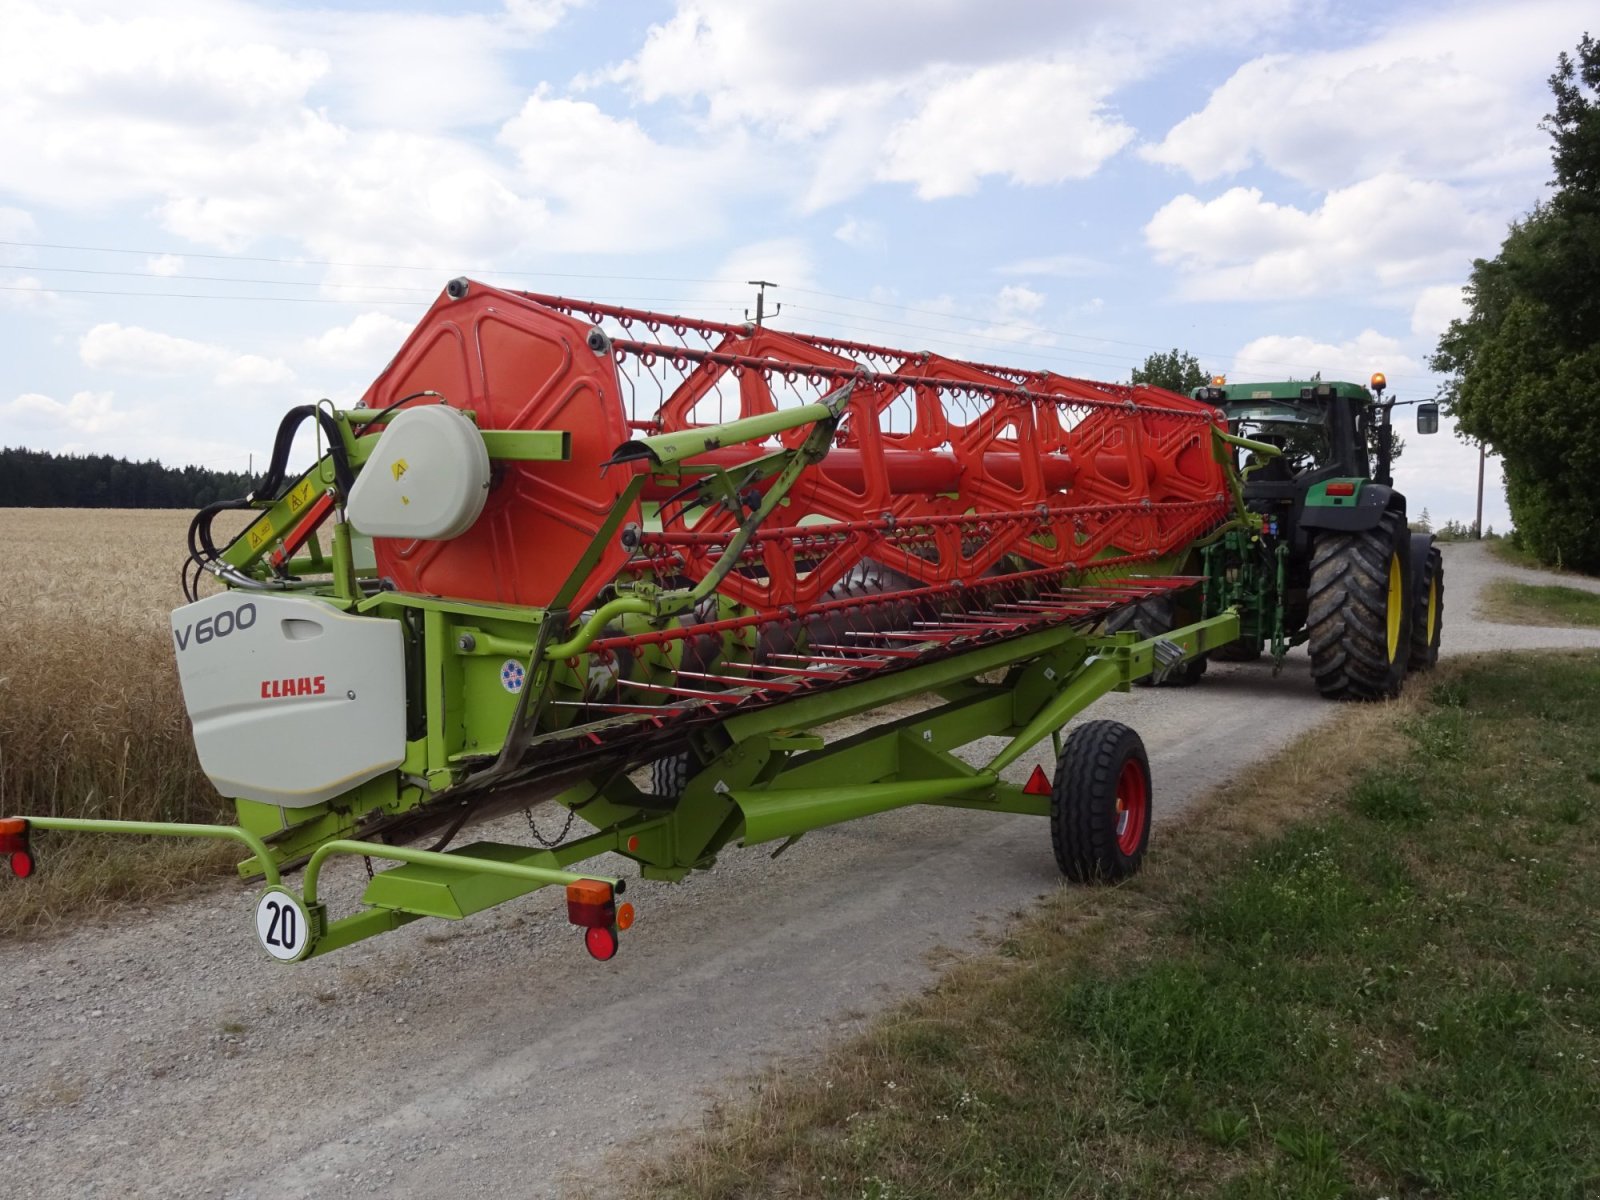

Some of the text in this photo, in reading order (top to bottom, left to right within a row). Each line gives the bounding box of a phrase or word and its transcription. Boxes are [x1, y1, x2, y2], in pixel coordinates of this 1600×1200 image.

[174, 602, 257, 651] V600
[260, 676, 326, 699] CLAAS
[266, 900, 296, 950] 20
